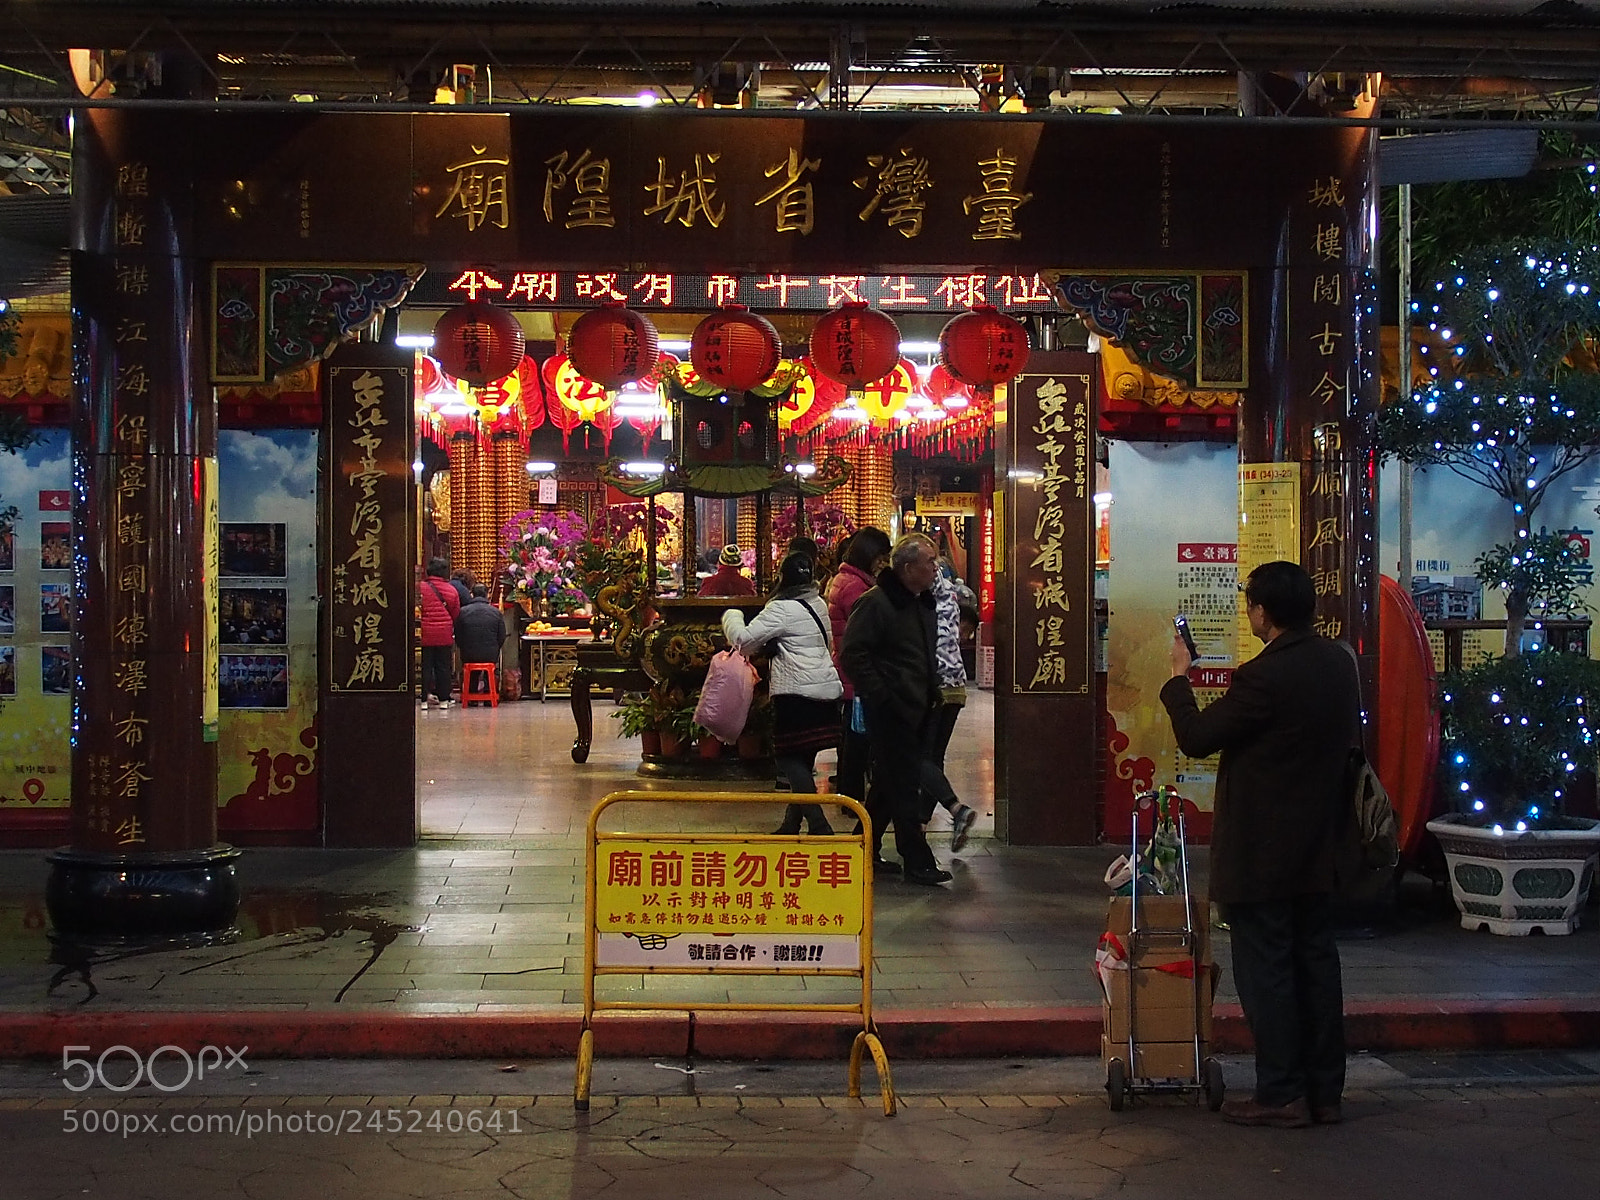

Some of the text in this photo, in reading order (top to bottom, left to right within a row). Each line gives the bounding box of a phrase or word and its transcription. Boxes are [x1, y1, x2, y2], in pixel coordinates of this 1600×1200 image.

[436, 145, 1034, 241] 臺灣省城隍廟
[607, 850, 853, 889] 廟前請勿停車
[641, 891, 803, 910] 以示對神明尊敬
